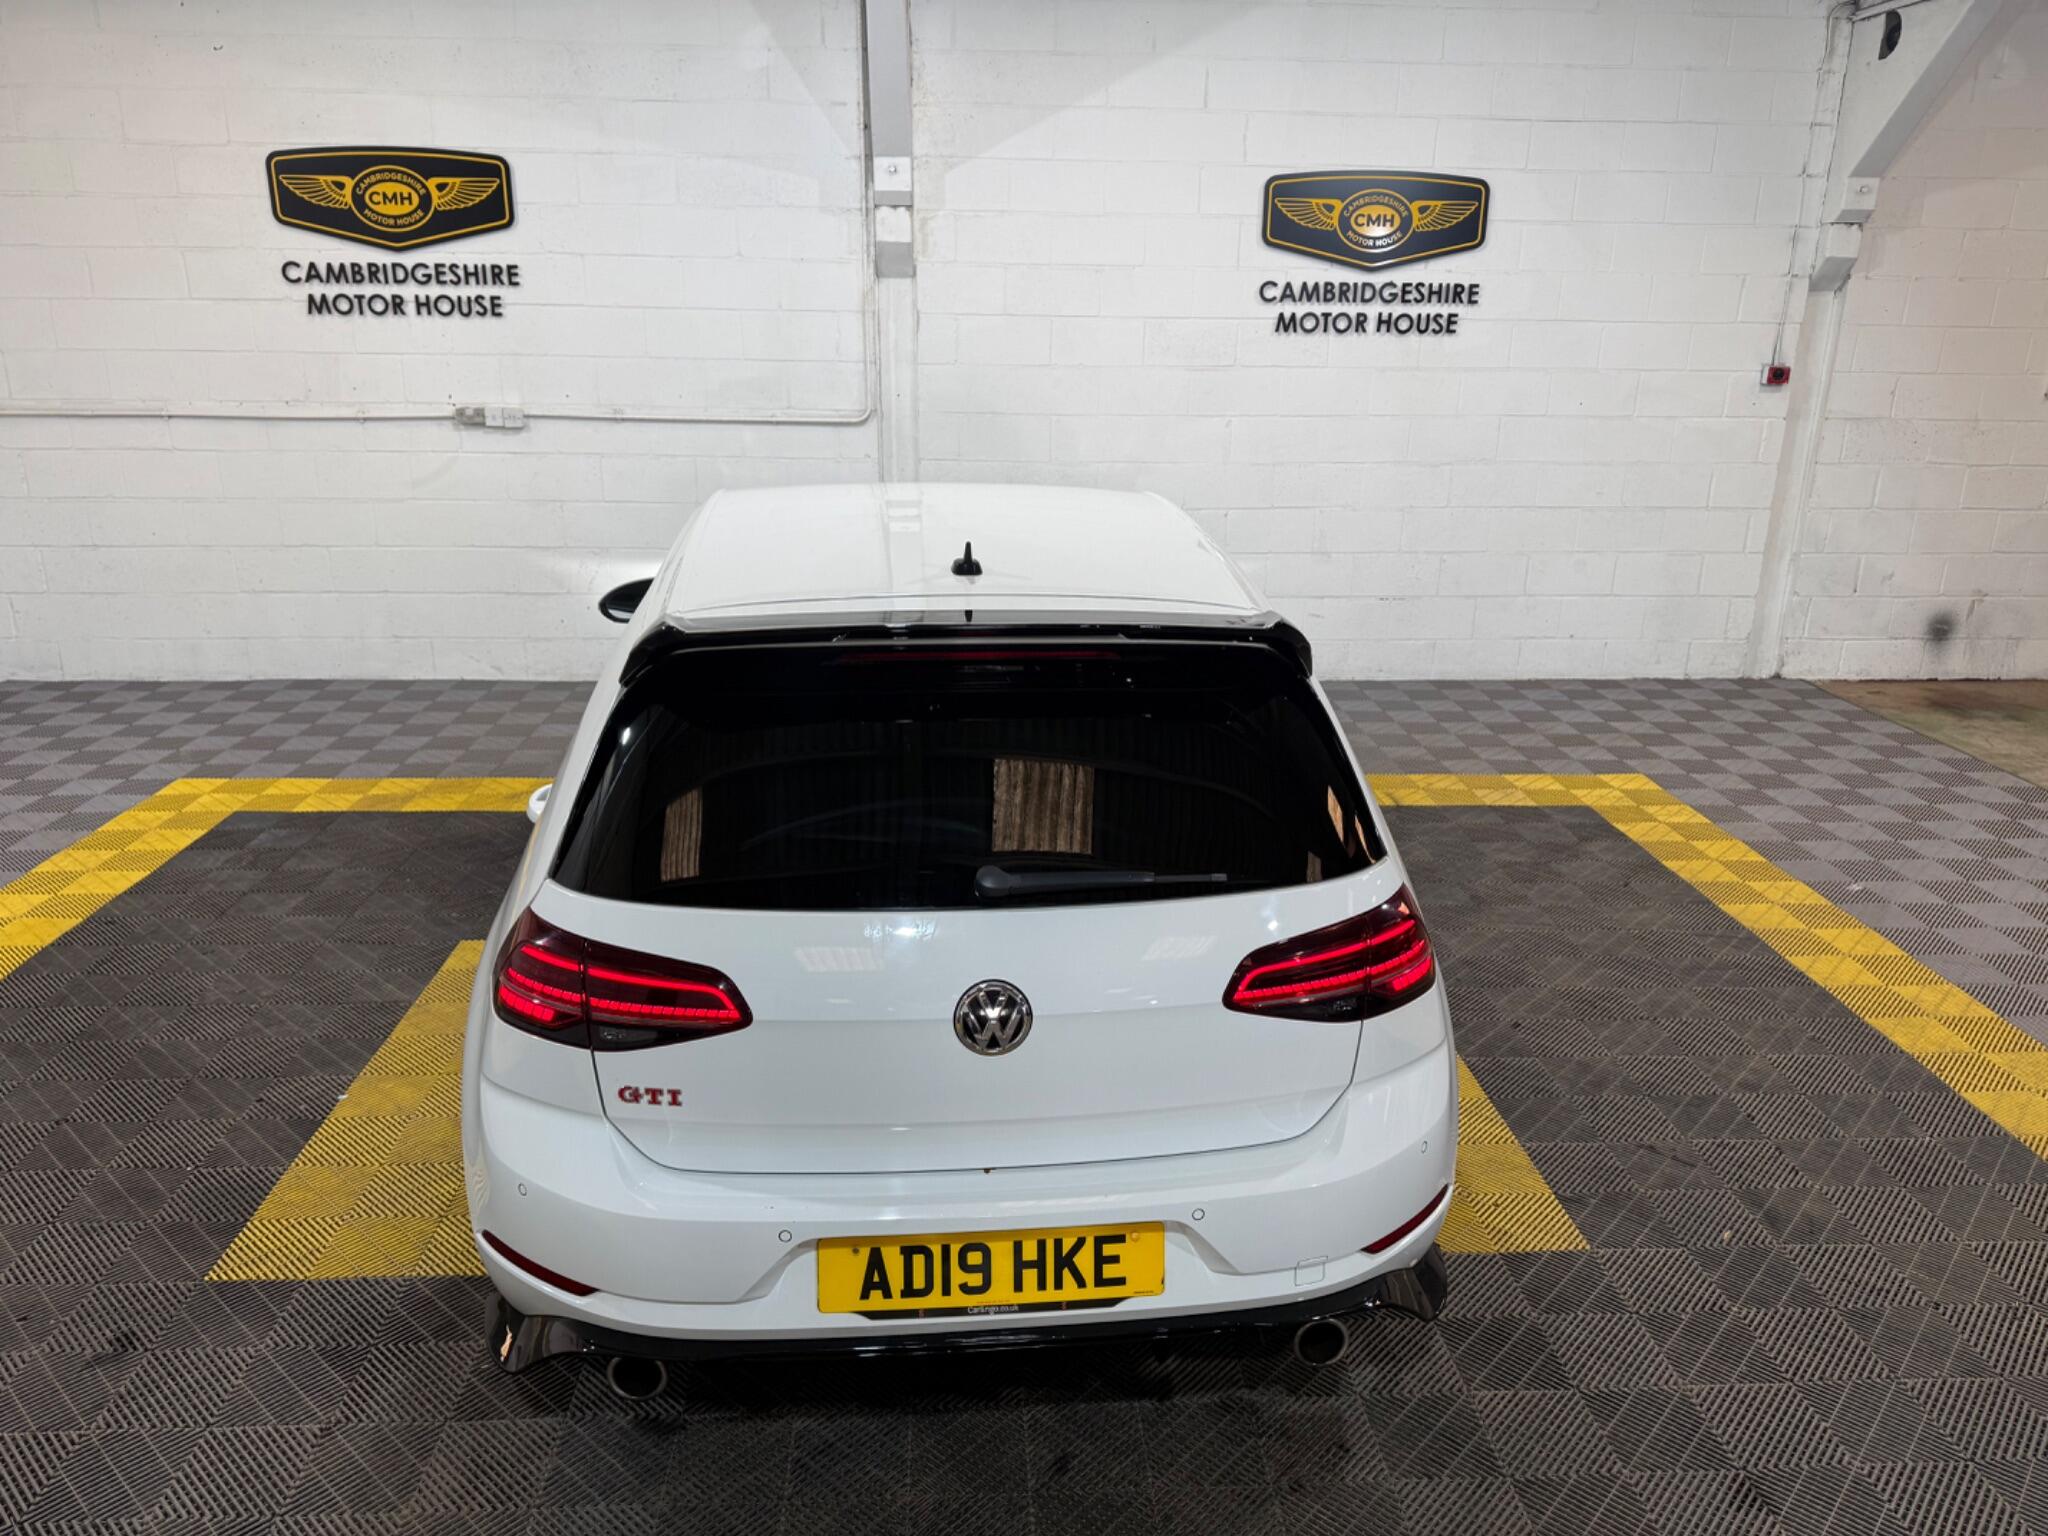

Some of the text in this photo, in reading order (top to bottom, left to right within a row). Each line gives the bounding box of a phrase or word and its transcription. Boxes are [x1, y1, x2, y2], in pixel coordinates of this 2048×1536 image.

[355, 173, 427, 197] CAMBRIDGESHIRE
[368, 191, 413, 206] CMH
[1343, 194, 1409, 218] CAMBRIDGESHIRE
[363, 208, 425, 226] MOTOR HOUSE
[1353, 213, 1396, 228] CMH
[1346, 231, 1403, 247] MOTOR HOUSE
[281, 261, 520, 286] CAMBRIDGESHIRE
[1258, 280, 1481, 305] CAMBRIDGESHIRE
[307, 293, 503, 318] MOTOR HOUSE
[1274, 311, 1460, 335] MOTOR HOUSE
[617, 1085, 683, 1107] GTI
[859, 1233, 1128, 1301] AD19 HKE
